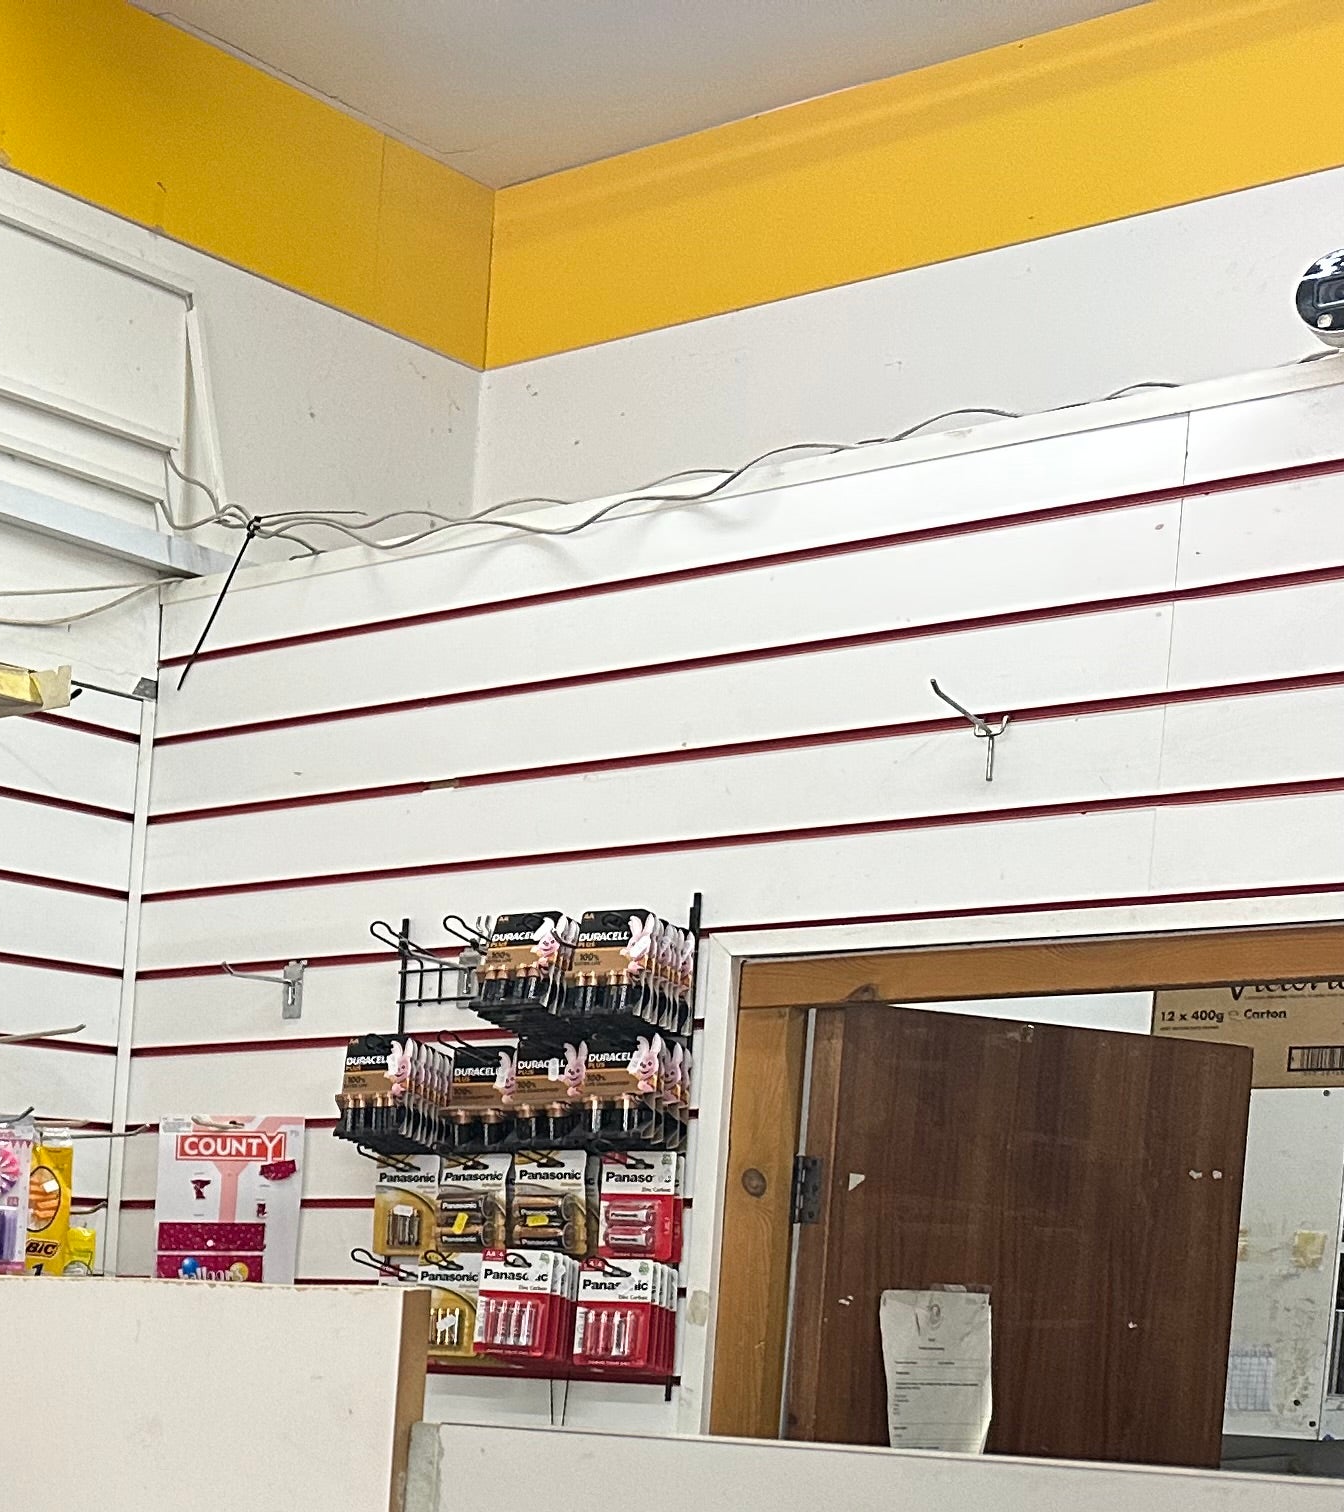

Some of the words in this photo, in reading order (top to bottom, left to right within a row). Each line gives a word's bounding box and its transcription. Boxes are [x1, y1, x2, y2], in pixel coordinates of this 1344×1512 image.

[579, 930, 630, 943] DURACELL
[1161, 1011, 1175, 1022] 12
[1191, 1009, 1224, 1023] 400g
[1244, 1008, 1287, 1020] Carton
[184, 1133, 285, 1161] COUNTY
[379, 1171, 436, 1184] Panasonic
[444, 1171, 503, 1181] Panasonic
[519, 1169, 582, 1181] Panasonic
[26, 1241, 58, 1255] BIC
[420, 1271, 479, 1283] Panasonic
